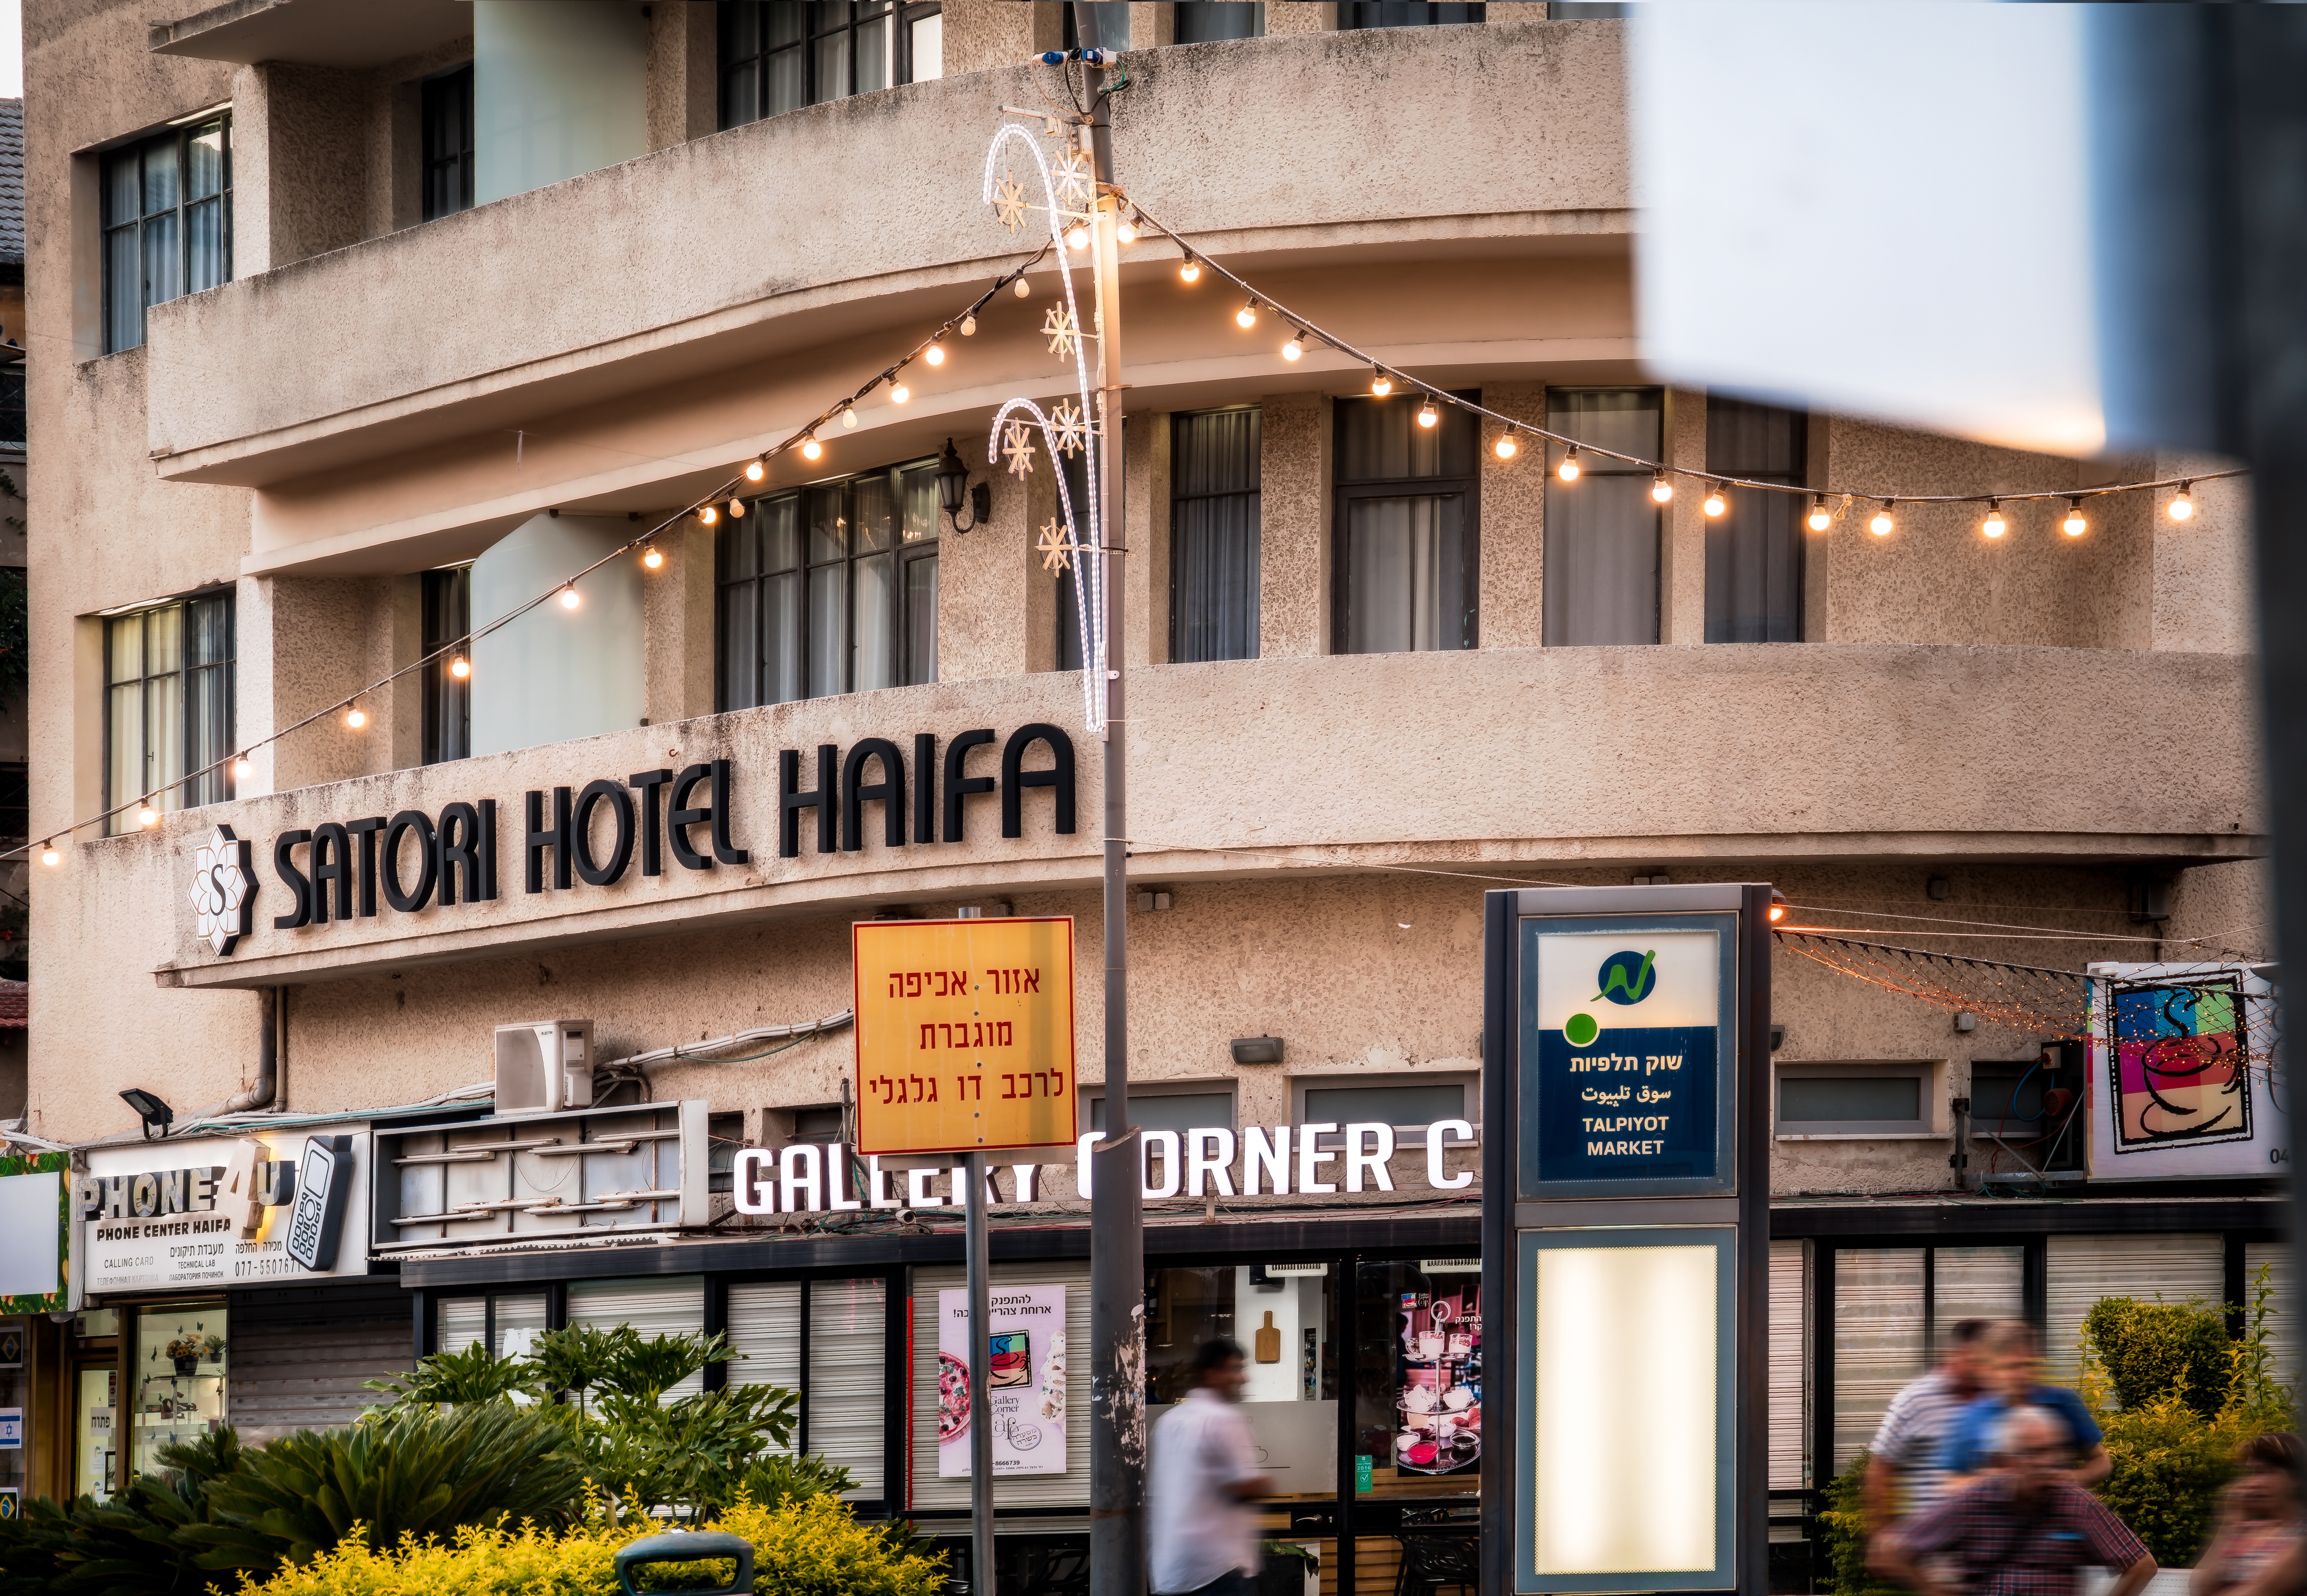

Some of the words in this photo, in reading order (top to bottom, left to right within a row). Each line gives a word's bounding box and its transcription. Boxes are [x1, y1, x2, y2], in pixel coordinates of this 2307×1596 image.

[274, 799, 497, 929] SATORI
[525, 759, 749, 894] HOTEL
[779, 723, 1076, 858] HAIFA
[209, 864, 226, 916] S
[889, 971, 967, 998] אכיפה
[986, 968, 1040, 994] אזור
[920, 1021, 1012, 1049] מוגברת
[1569, 1053, 1638, 1072] תלפיות
[1646, 1054, 1683, 1076] שוק
[869, 1073, 938, 1104] גלגלי
[957, 1075, 982, 1101] דו
[1002, 1067, 1063, 1099] לרכב
[1637, 1085, 1671, 1103] سوق
[1582, 1116, 1669, 1132] TALPIYOT
[1588, 1140, 1664, 1156] MARKET
[75, 1167, 219, 1222] PHONE
[215, 1138, 266, 1240] 4
[257, 1161, 290, 1206] U
[97, 1226, 139, 1242] PHONE
[144, 1221, 189, 1238] CENTER
[193, 1218, 230, 1234] HAIFA
[170, 1245, 195, 1259] תיקונים
[197, 1243, 224, 1256] מעבדת
[235, 1240, 257, 1254] החלפה
[263, 1240, 282, 1252] מכירה
[104, 1257, 133, 1269] CALLING
[135, 1256, 154, 1267] CARD
[178, 1261, 204, 1269] TECHNICAL
[205, 1259, 215, 1267] LAB
[97, 1276, 131, 1286] ТЕЛЕФОННАЯ
[132, 1274, 159, 1284] КАРТОЧКА
[169, 1272, 201, 1282] ЛАБОРАТОРИЯ
[202, 1271, 224, 1280] ПОЧИНОК
[991, 1294, 1032, 1307] להתפנק
[1020, 1306, 1052, 1315] ארוחת
[1455, 1316, 1482, 1324] התפנק
[991, 1396, 1020, 1406] Gallery
[991, 1404, 1019, 1413] Corner
[91, 1416, 110, 1428] פתוח
[1016, 1434, 1037, 1446] כשרה
